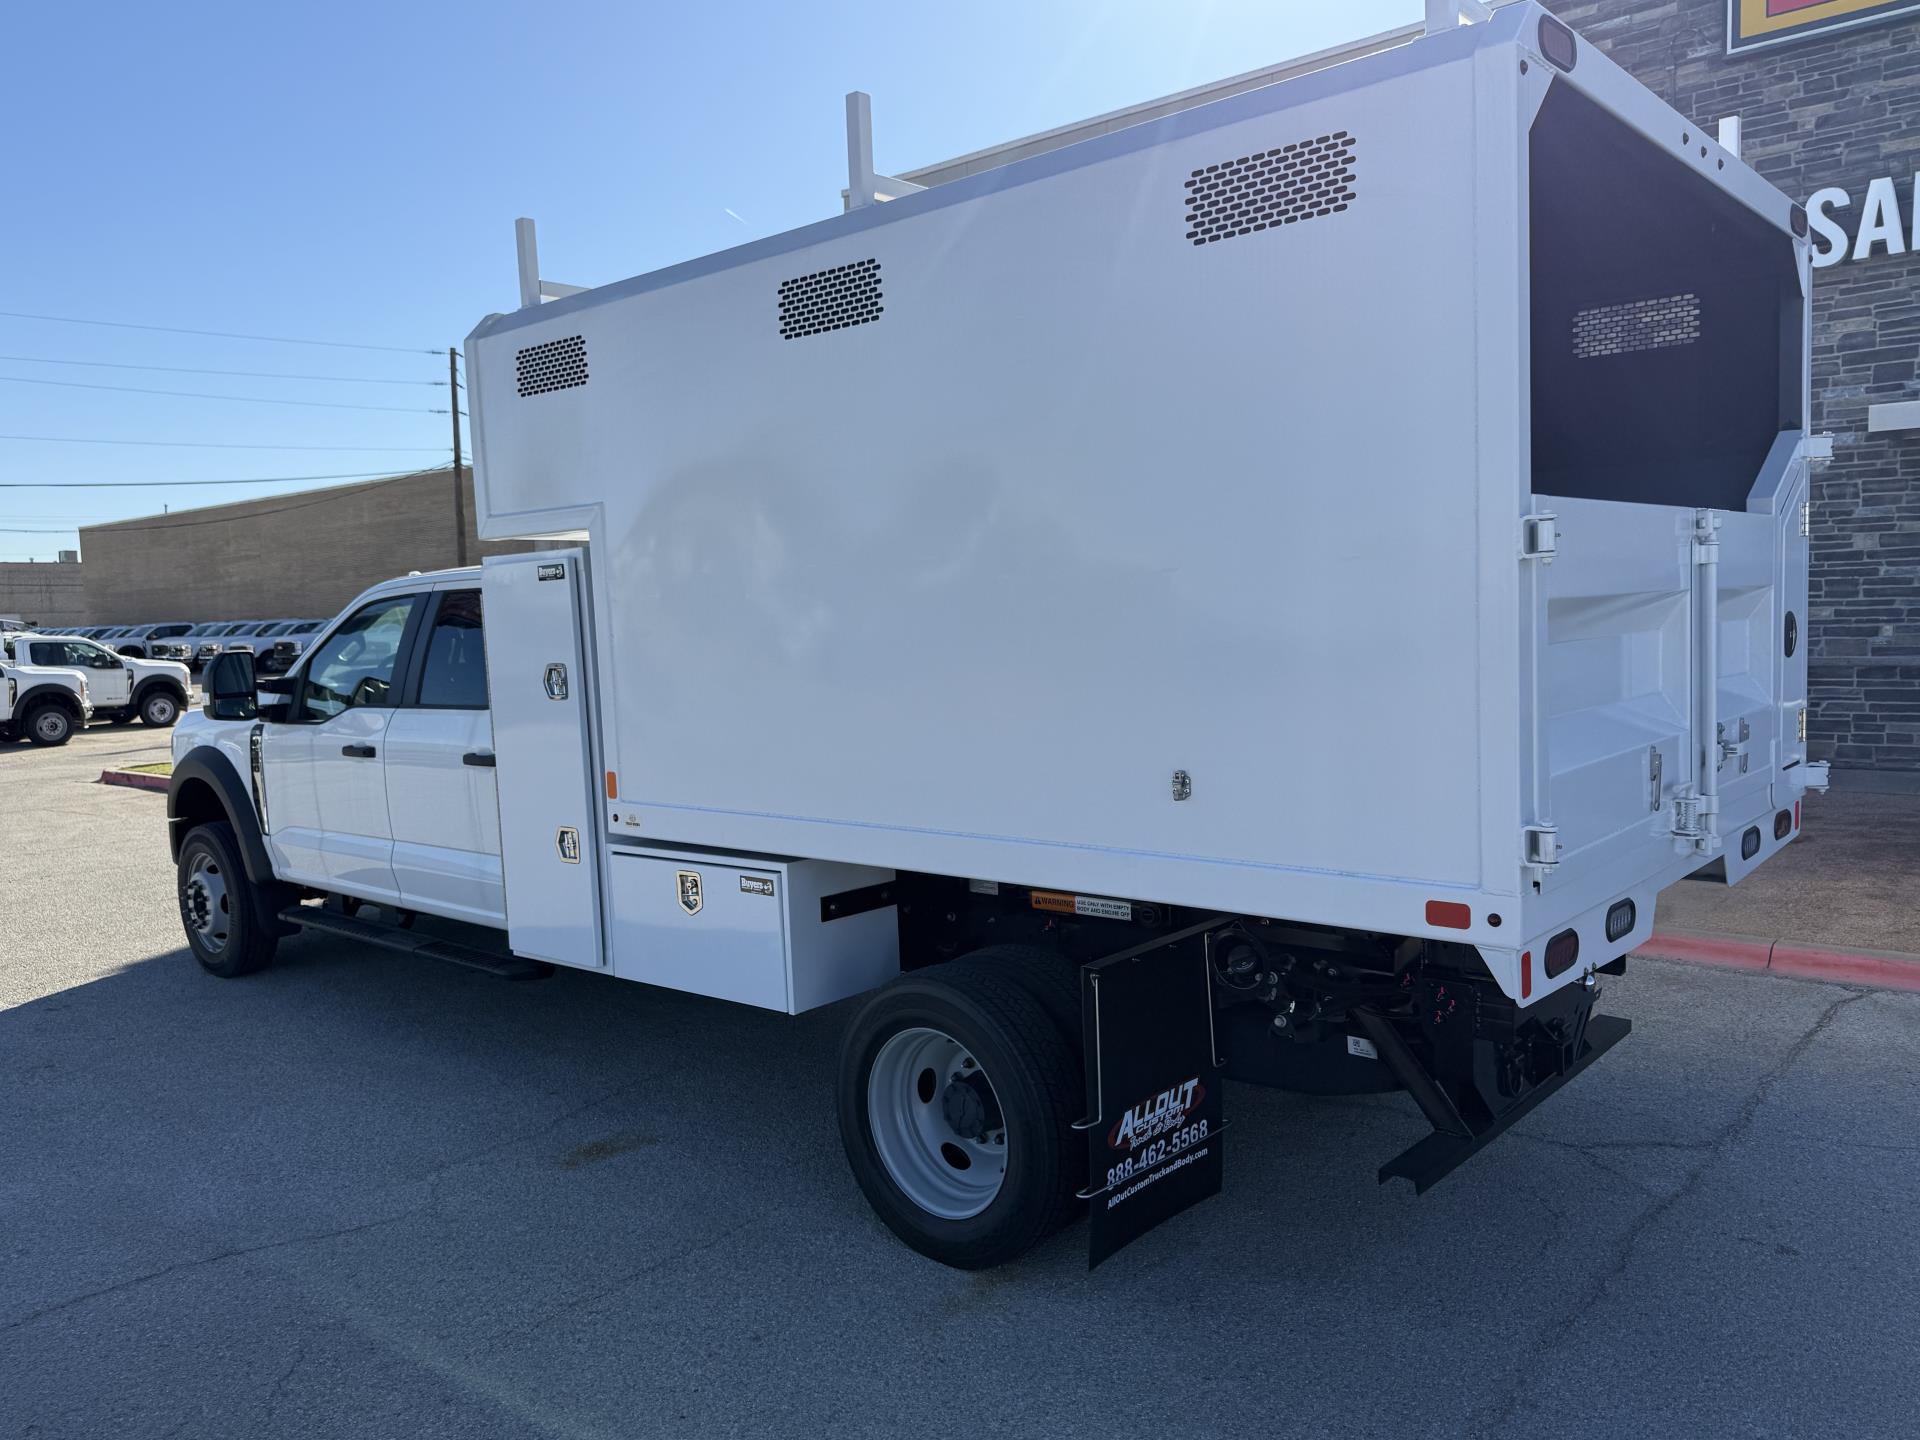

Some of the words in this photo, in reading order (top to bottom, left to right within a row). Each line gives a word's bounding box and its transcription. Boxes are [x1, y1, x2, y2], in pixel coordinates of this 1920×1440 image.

[1805, 171, 1920, 268] SA
[1041, 897, 1074, 908] WARNING
[1101, 908, 1120, 917] ENGINE
[1113, 903, 1130, 911] EMPTY
[1107, 1119, 1208, 1190] 888-462-5568
[1107, 1148, 1208, 1210] AllOutCustomTruckandBody.com
